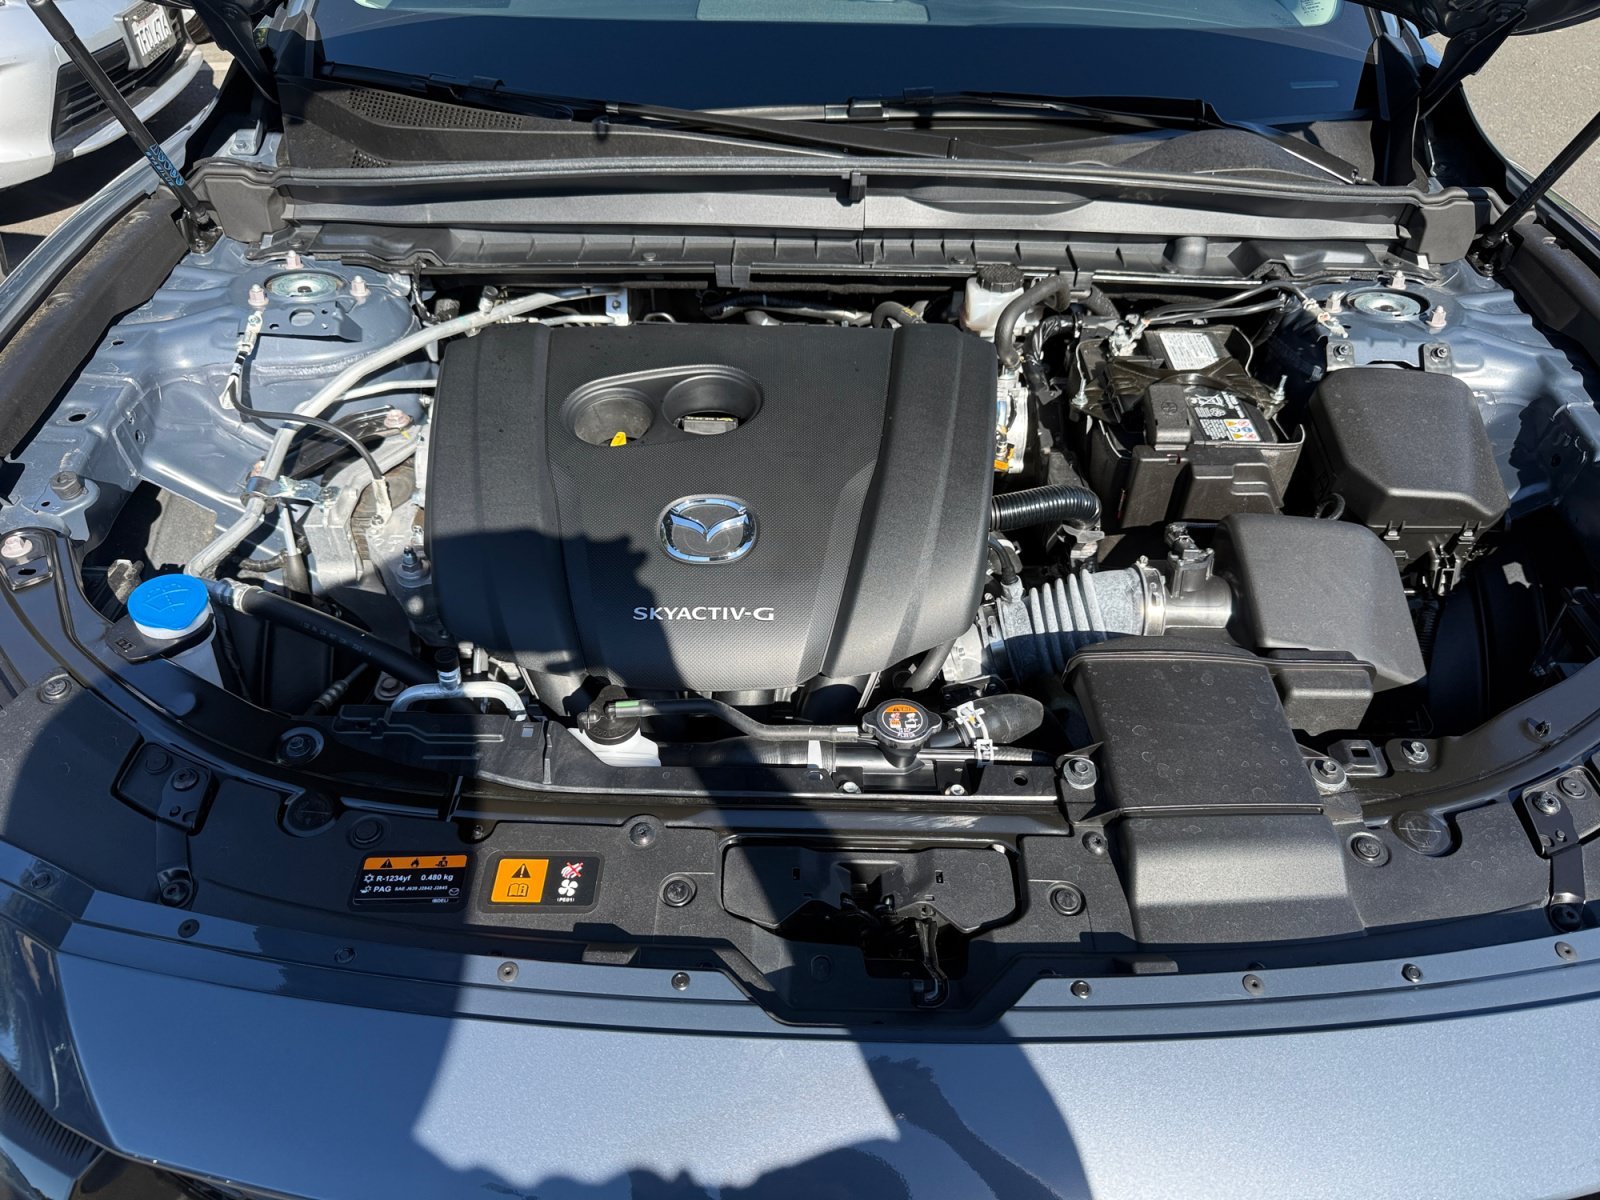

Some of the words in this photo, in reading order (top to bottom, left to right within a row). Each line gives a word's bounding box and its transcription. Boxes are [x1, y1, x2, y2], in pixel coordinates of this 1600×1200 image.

[632, 606, 775, 621] SKYACTIV-G
[375, 874, 412, 883] R-1234yf
[443, 873, 454, 882] kg
[373, 885, 392, 893] PAG
